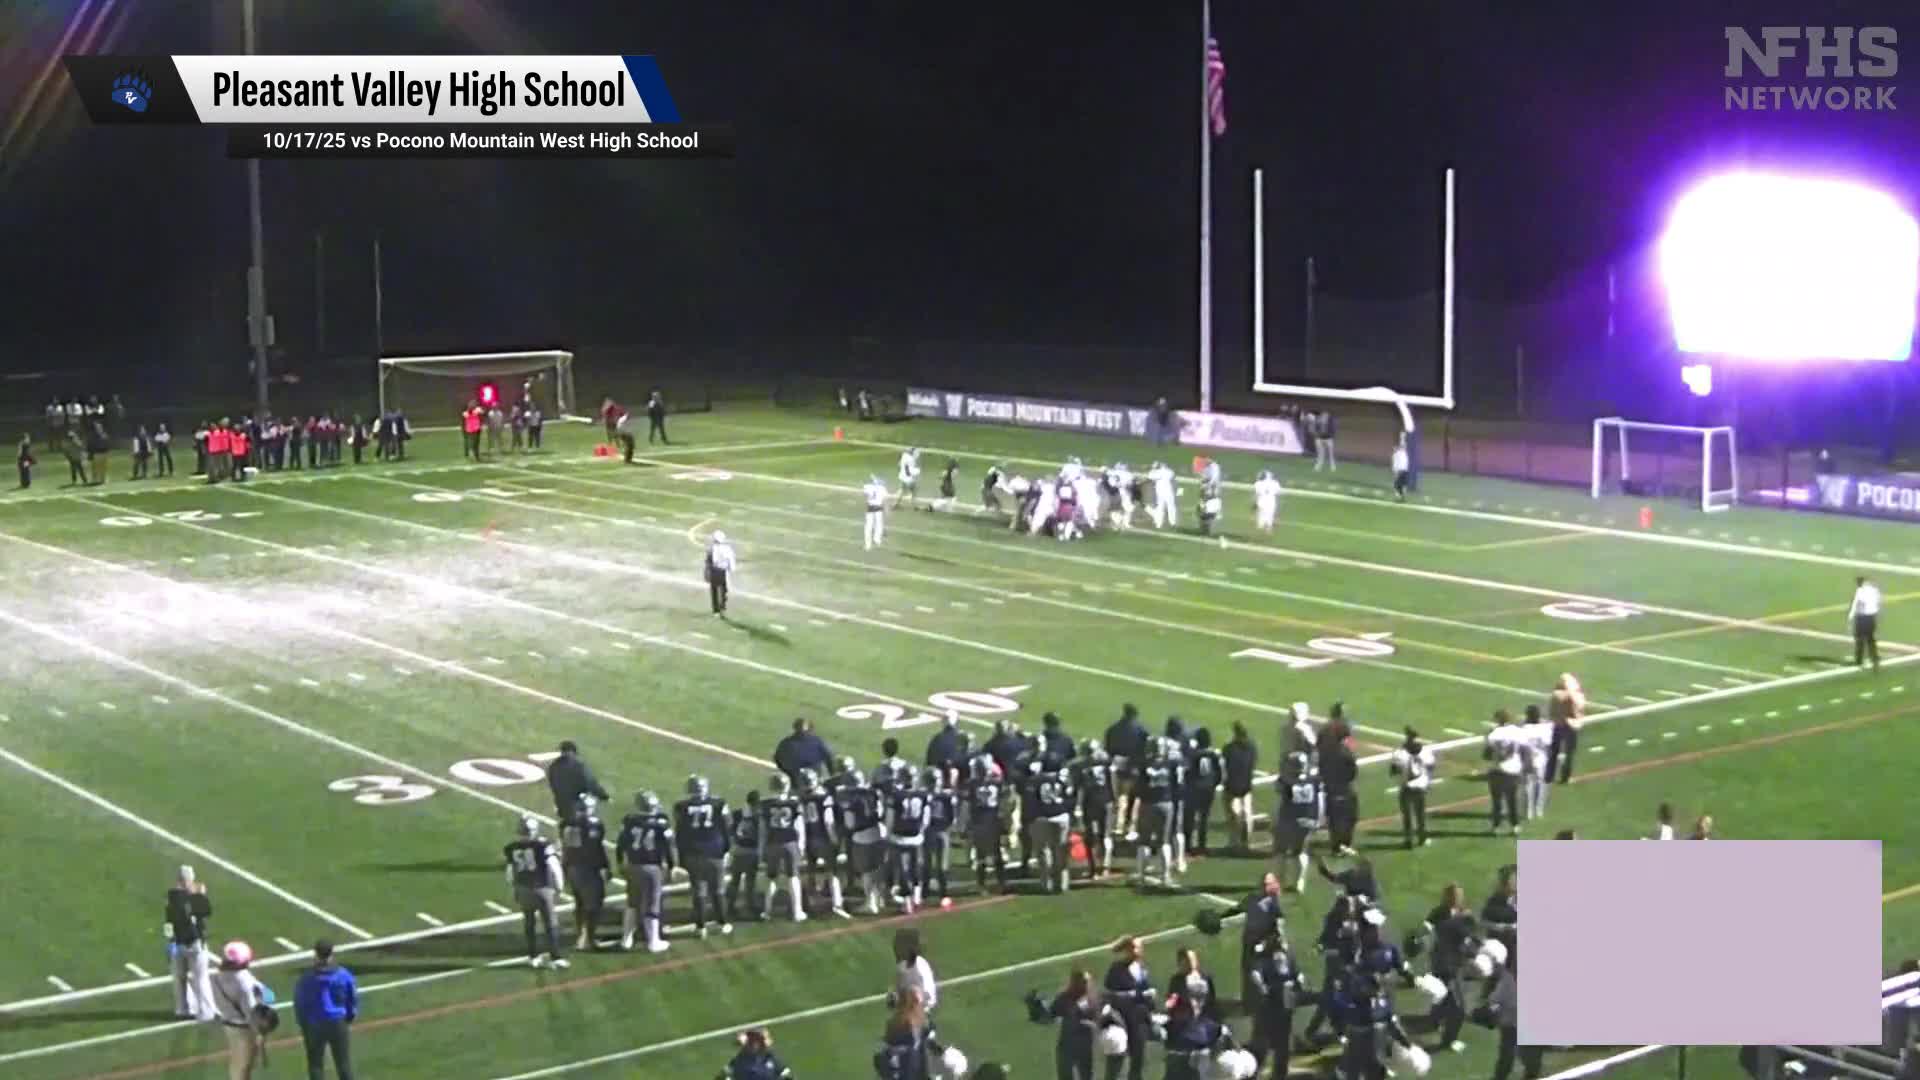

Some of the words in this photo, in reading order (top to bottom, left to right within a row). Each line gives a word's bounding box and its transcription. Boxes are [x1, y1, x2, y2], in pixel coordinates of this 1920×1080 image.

[1016, 401, 1082, 426] MOUNTAIN
[1084, 408, 1123, 430] WEST
[687, 803, 713, 828] 77
